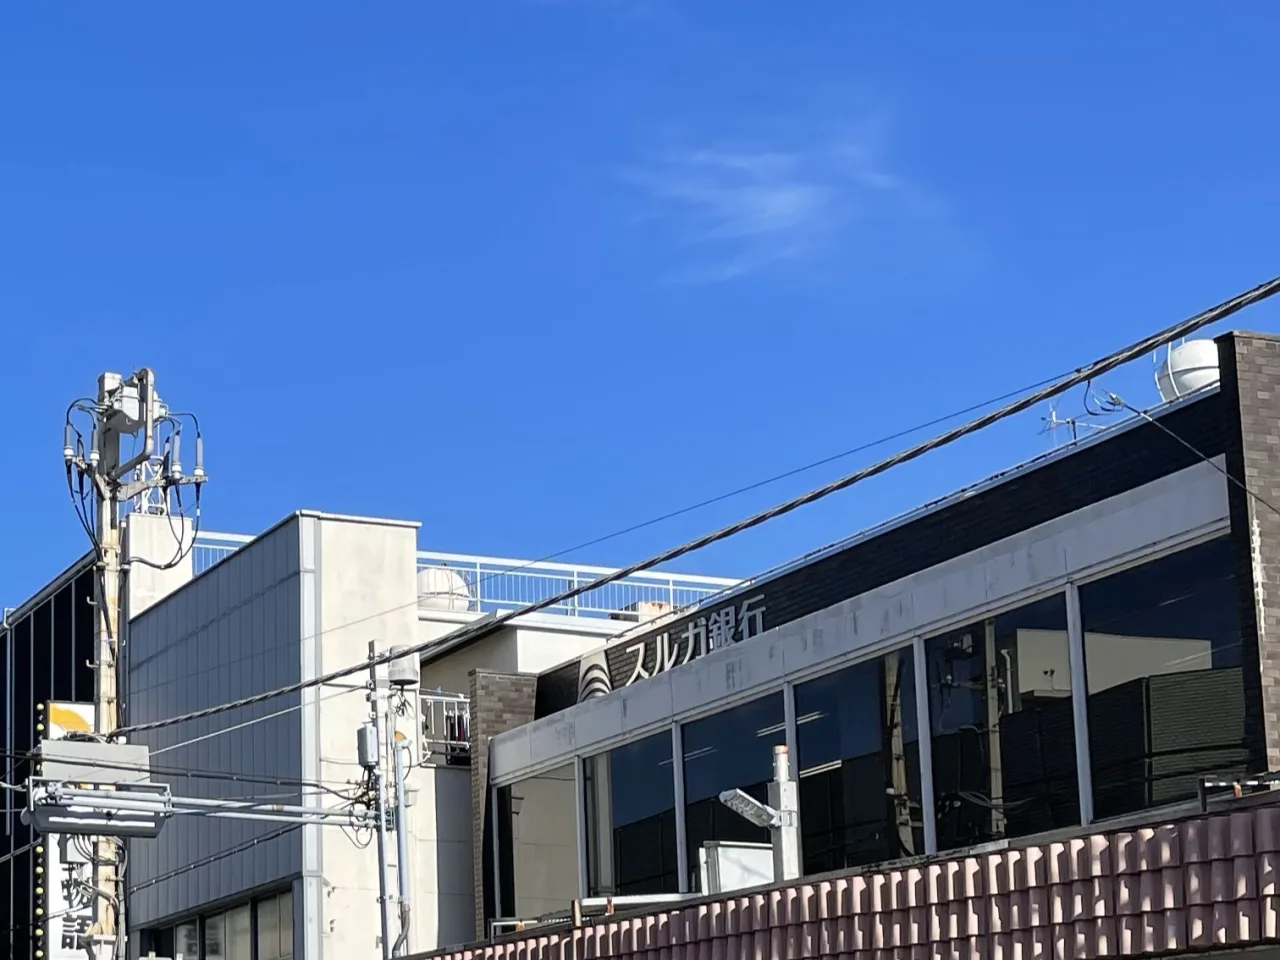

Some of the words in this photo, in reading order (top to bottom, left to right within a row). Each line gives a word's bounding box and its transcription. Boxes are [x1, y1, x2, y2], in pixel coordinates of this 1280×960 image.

[625, 594, 766, 687] スルガ銀行
[61, 864, 93, 950] 物語
